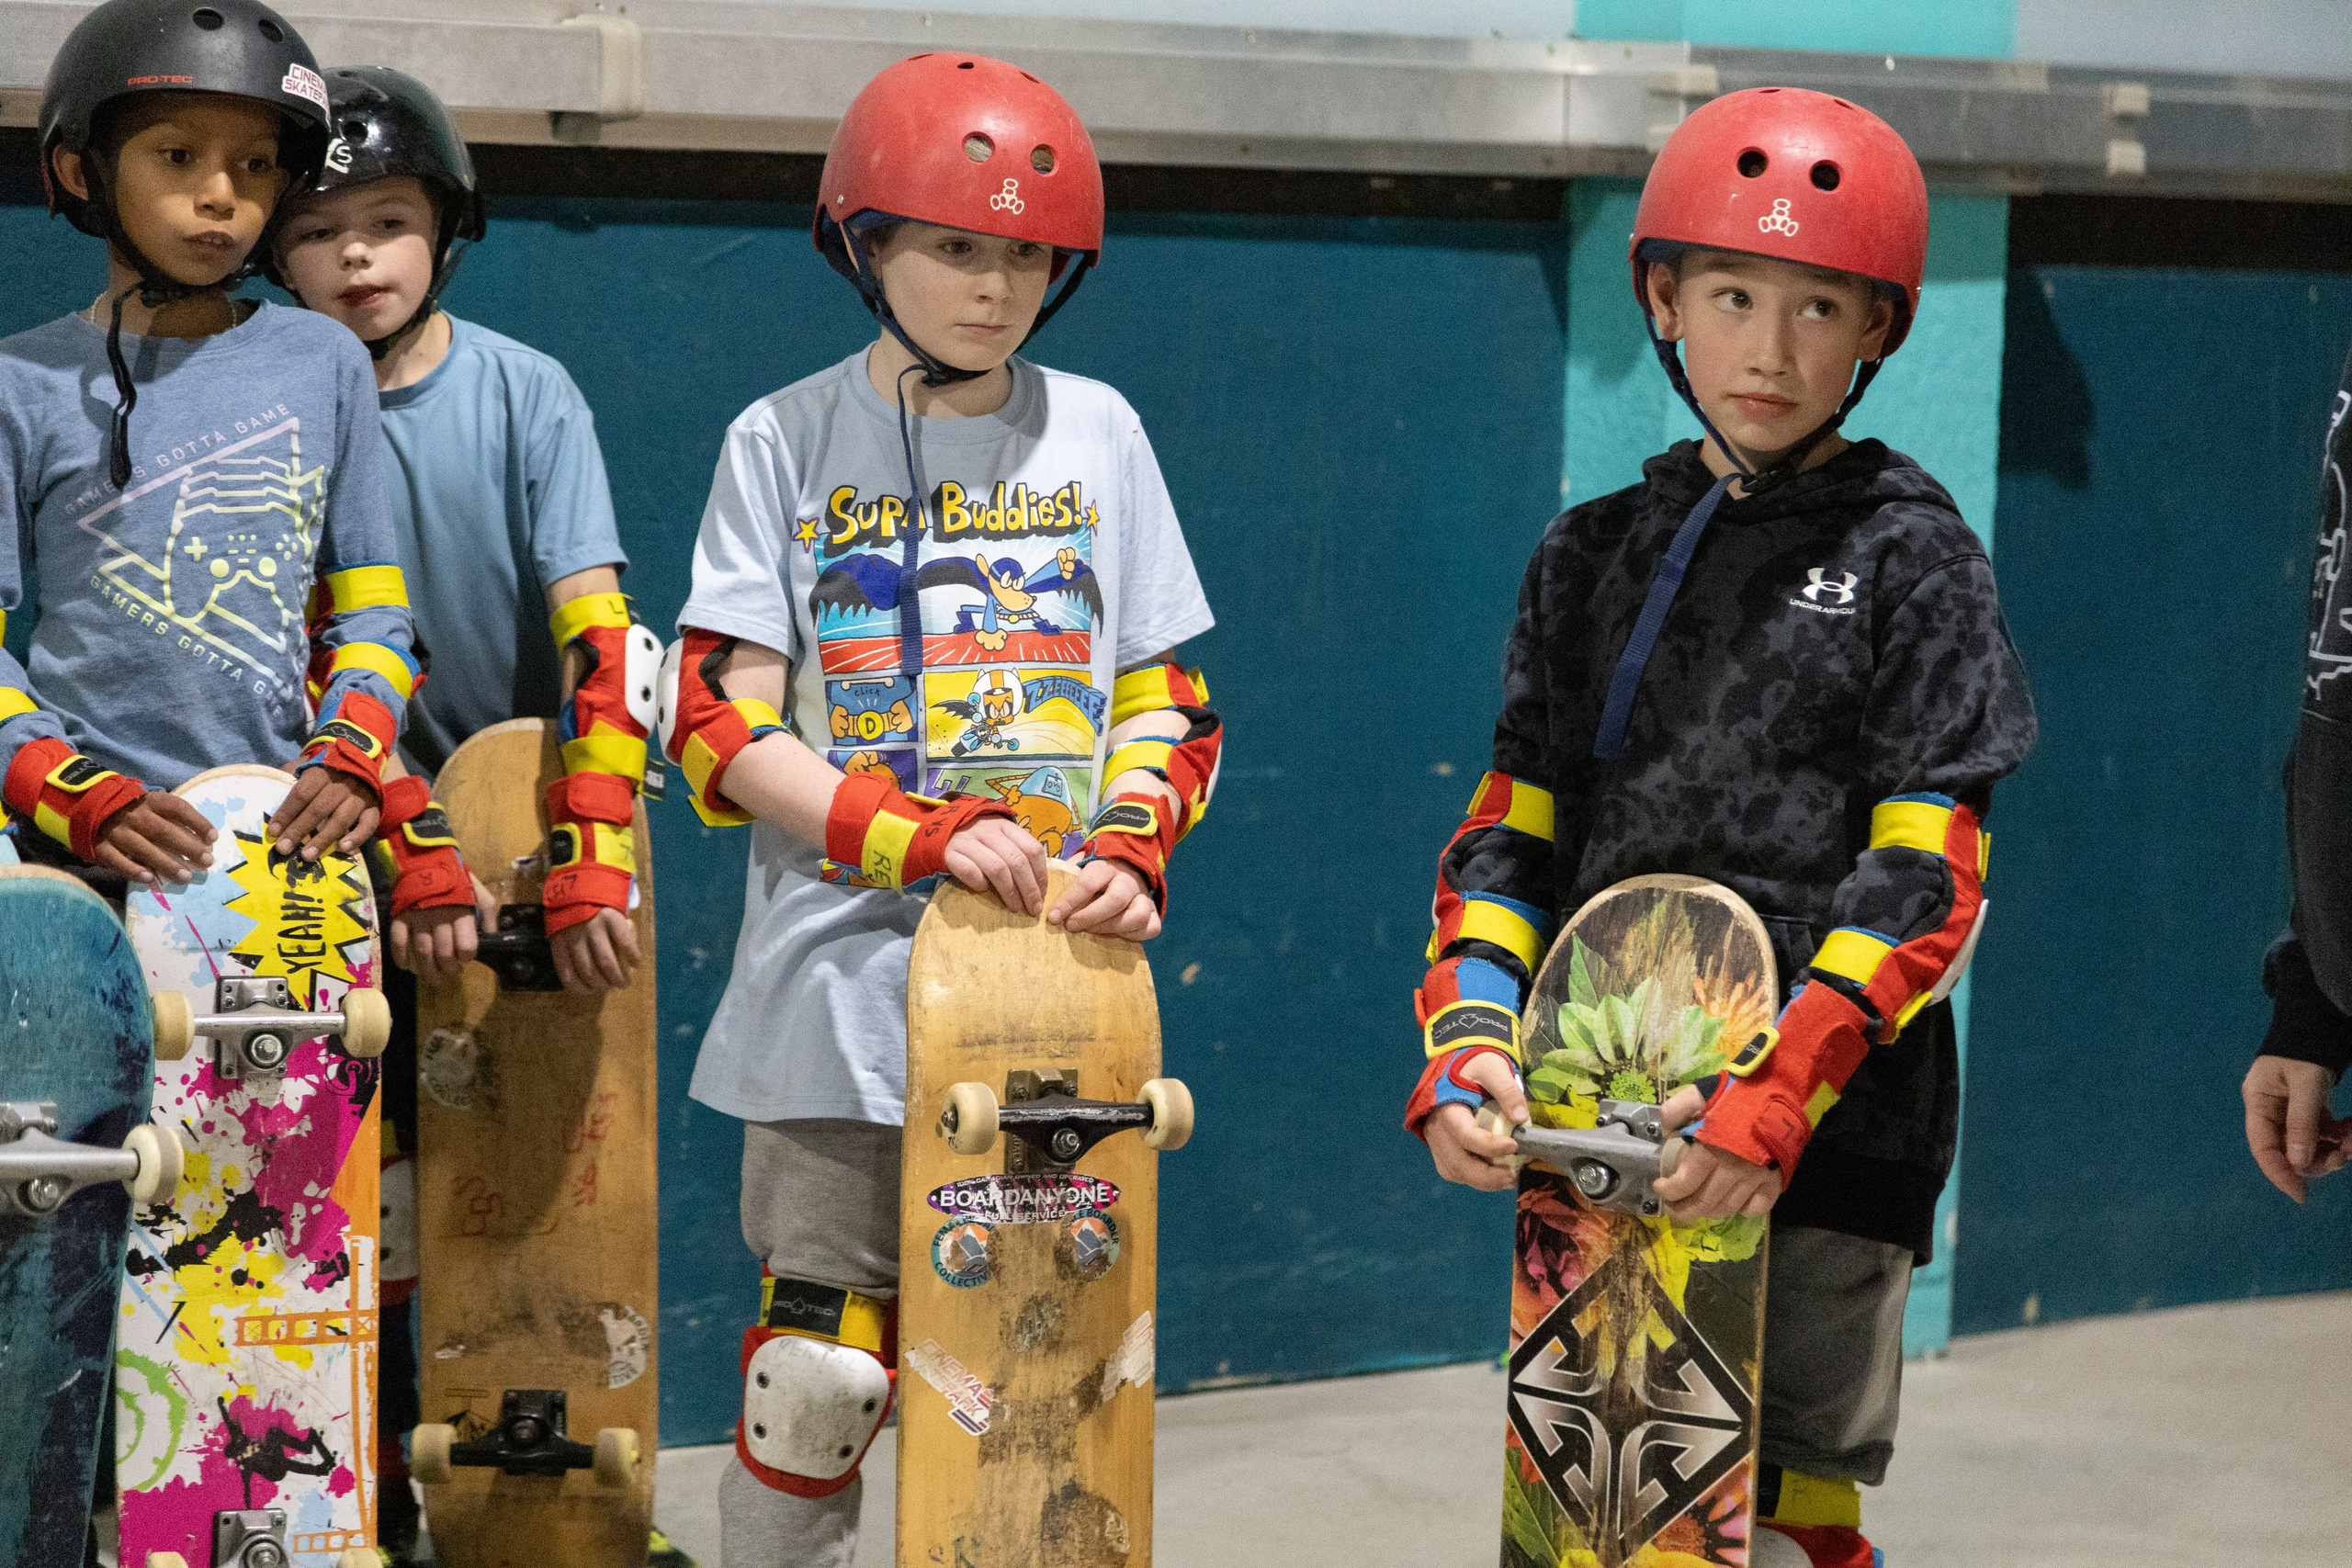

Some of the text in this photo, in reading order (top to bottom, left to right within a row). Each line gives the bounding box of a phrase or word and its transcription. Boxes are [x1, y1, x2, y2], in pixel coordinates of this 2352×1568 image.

[64, 403, 290, 515] GAMES GOTTA GAME
[933, 480, 1083, 538] Buddies!
[1789, 598, 1822, 612] UNDER
[89, 574, 170, 637] GAMERS
[176, 634, 243, 682] GOTTA
[865, 716, 876, 735] D
[277, 890, 327, 975] YEAH!
[1433, 1016, 1510, 1040] PRO TEC
[939, 1184, 1111, 1207] BOARDANYONE
[1016, 1210, 1066, 1222] SERVICE
[933, 1261, 989, 1288] COLLECTIV
